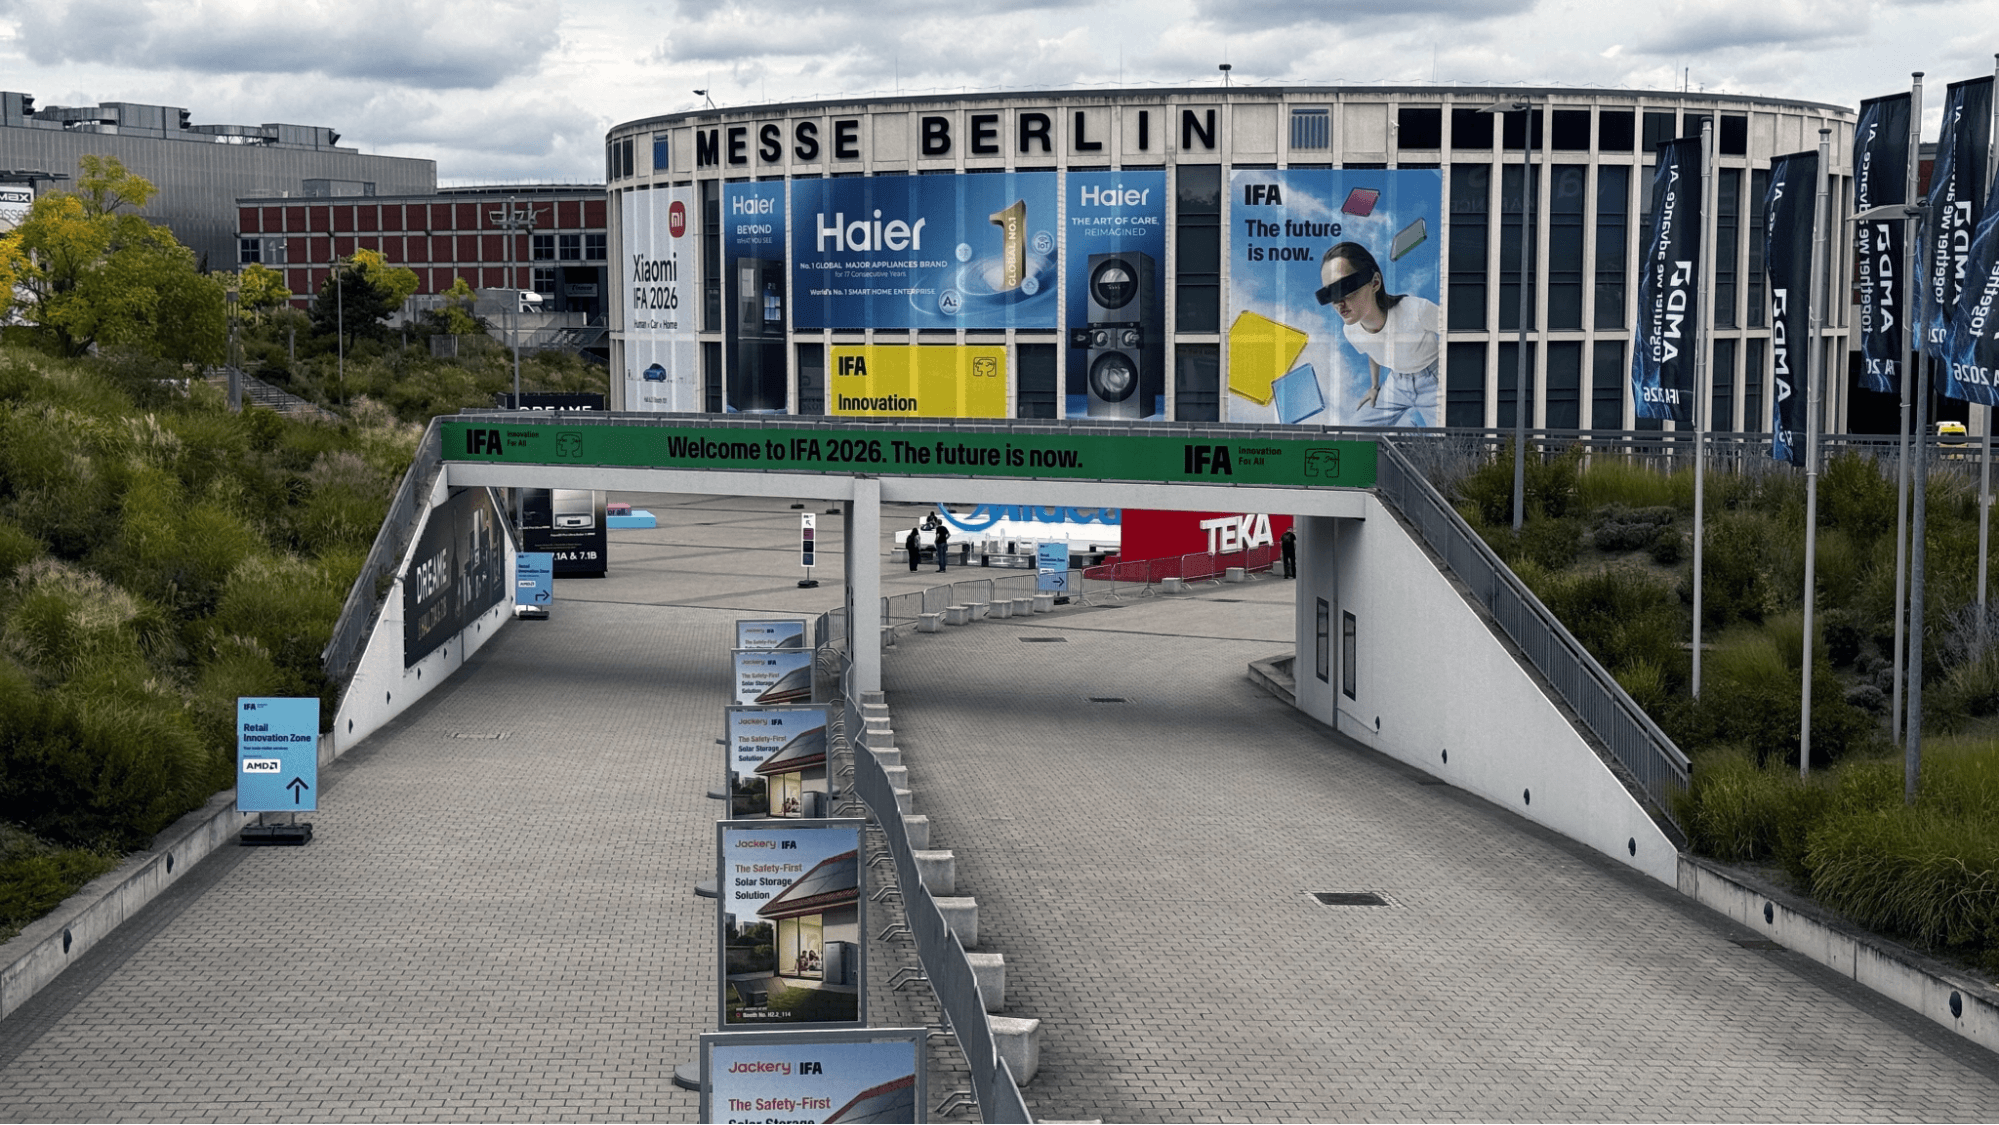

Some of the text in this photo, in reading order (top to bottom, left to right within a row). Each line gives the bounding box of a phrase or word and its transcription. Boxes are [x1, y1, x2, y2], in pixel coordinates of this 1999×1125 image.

[697, 109, 1215, 167] MESSE BERLIN
[1081, 184, 1149, 206] Haier
[1244, 184, 1282, 205] IFA
[733, 194, 775, 215] Haier
[1072, 217, 1159, 226] THE ART OF CARE,
[737, 224, 772, 235] BEYOND
[817, 209, 926, 252] Haier
[1084, 227, 1146, 236] REIMAGINED
[1245, 219, 1342, 237] The future
[1008, 217, 1016, 286] GLOBAL NO.1
[1248, 243, 1314, 261] is now.
[633, 252, 677, 283] Xiaomi
[800, 262, 811, 270] No.
[845, 261, 870, 269] MAJOR
[872, 260, 918, 268] APPLIANCES
[919, 260, 948, 268] BRAND
[851, 270, 888, 278] Consecutive
[833, 288, 844, 296] No.
[848, 288, 871, 296] SMART
[633, 286, 678, 310] IFA 2026
[650, 319, 659, 329] Car
[663, 320, 678, 329] Home
[838, 356, 867, 376] IFA
[838, 394, 917, 411] Innovation
[507, 430, 540, 438] Innovation
[466, 429, 503, 455] IFA
[507, 439, 527, 447] For All
[667, 436, 1083, 468] Welcome to IFA 2026. The future is now.
[1238, 446, 1282, 455] Innovation
[1184, 445, 1233, 475] IFA
[1238, 457, 1265, 466] For All
[1200, 513, 1274, 557] TEKA
[570, 552, 577, 560] &
[580, 552, 597, 560] 7.1B
[411, 548, 447, 605] DREAME
[243, 703, 257, 711] IFA
[738, 718, 768, 726] Jackery
[243, 723, 268, 732] Retail
[243, 733, 311, 742] Innovation Zone
[751, 735, 786, 743] Safety-First
[246, 762, 269, 770] AMD
[735, 839, 797, 849] Jackery IFA
[735, 864, 802, 874] The Safety-First
[735, 877, 792, 887] Solar Storage
[735, 891, 770, 900] Solution
[728, 1061, 823, 1075] Jackery IFA
[728, 1097, 831, 1113] The Safety-First
